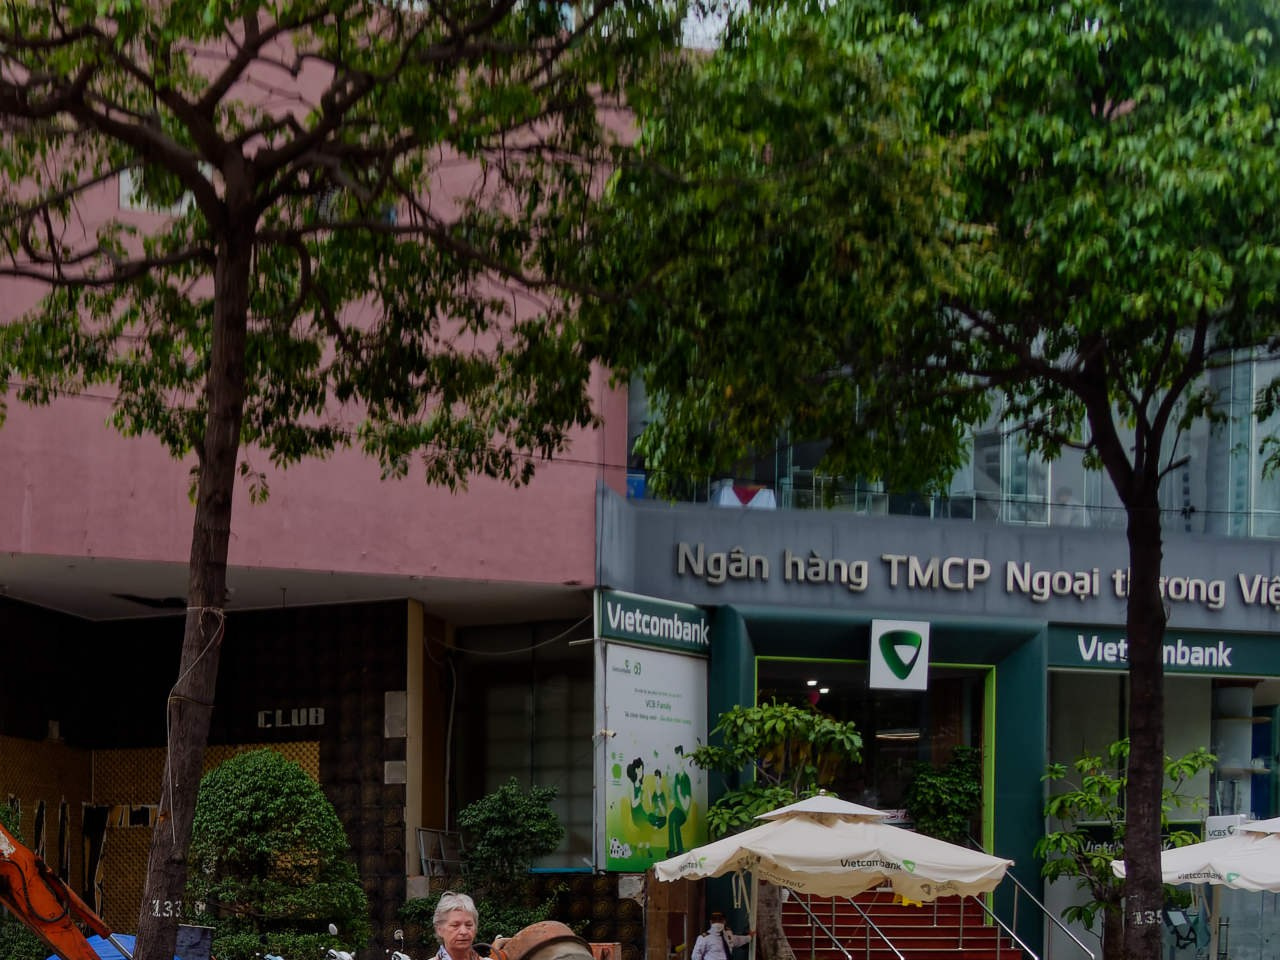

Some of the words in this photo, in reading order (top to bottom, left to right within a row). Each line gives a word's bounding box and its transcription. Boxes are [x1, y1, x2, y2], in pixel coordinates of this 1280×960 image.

[677, 542, 769, 586] Ngân
[784, 547, 869, 592] hàng
[881, 553, 991, 591] TMCP
[1005, 560, 1100, 600] Ngoại
[607, 601, 710, 645] Vietcombank
[257, 707, 325, 728] CLUB
[840, 857, 902, 871] Vietcombank
